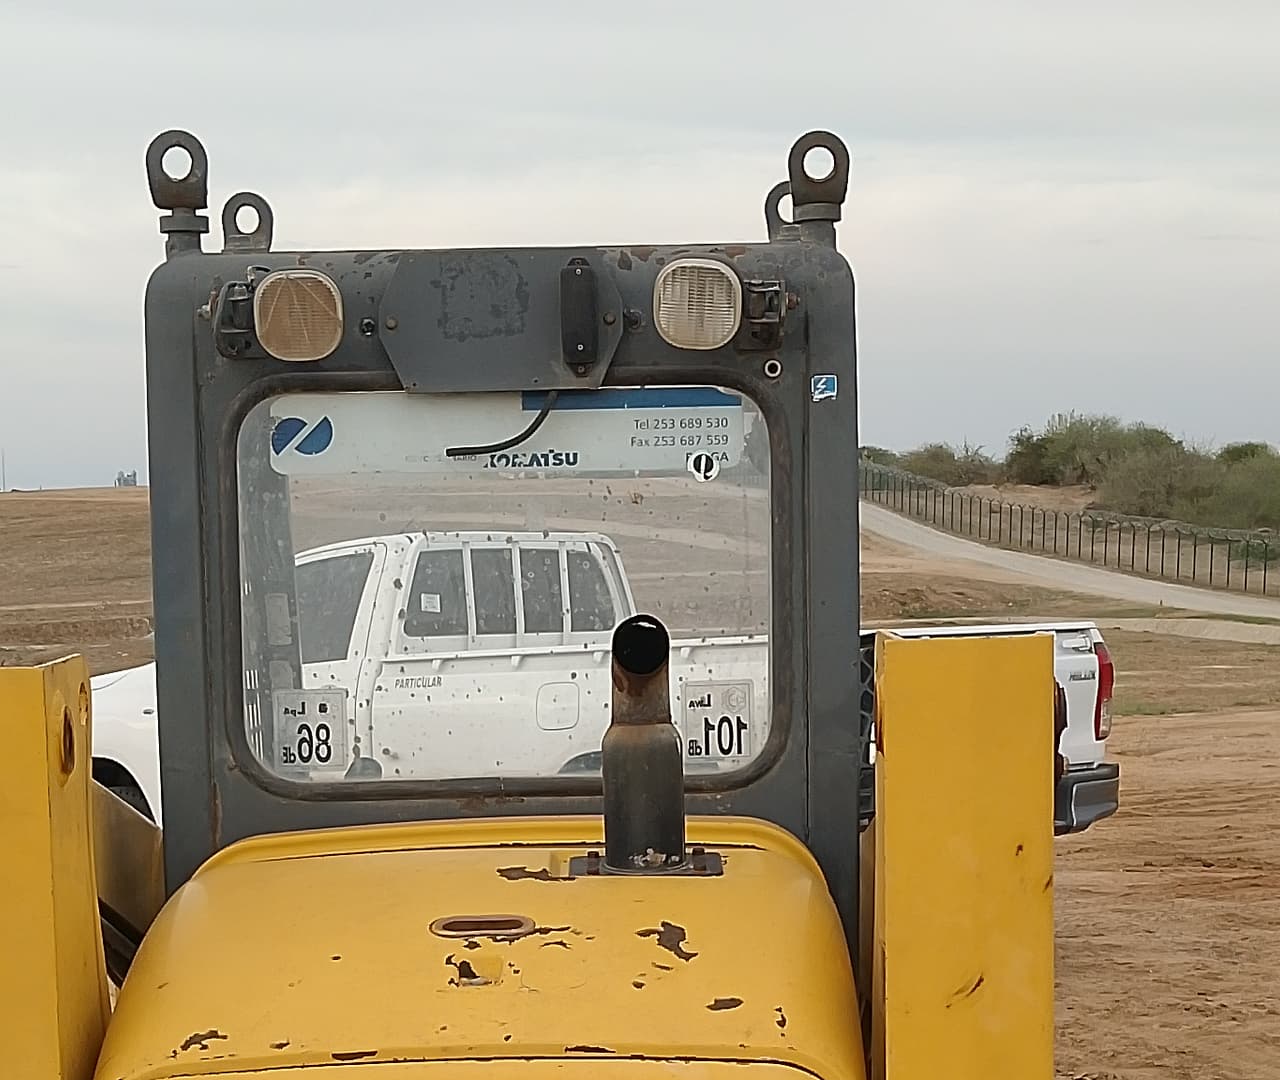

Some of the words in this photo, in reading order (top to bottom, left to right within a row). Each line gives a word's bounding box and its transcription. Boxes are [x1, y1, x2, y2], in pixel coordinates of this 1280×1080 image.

[634, 419, 649, 430] Tel
[653, 419, 675, 430] 253
[680, 418, 702, 429] 689
[706, 417, 728, 428] 530
[631, 436, 650, 447] Fax
[654, 436, 675, 447] 253
[680, 435, 701, 446] 687
[706, 434, 729, 446] 559
[394, 676, 442, 689] PARTICULAR
